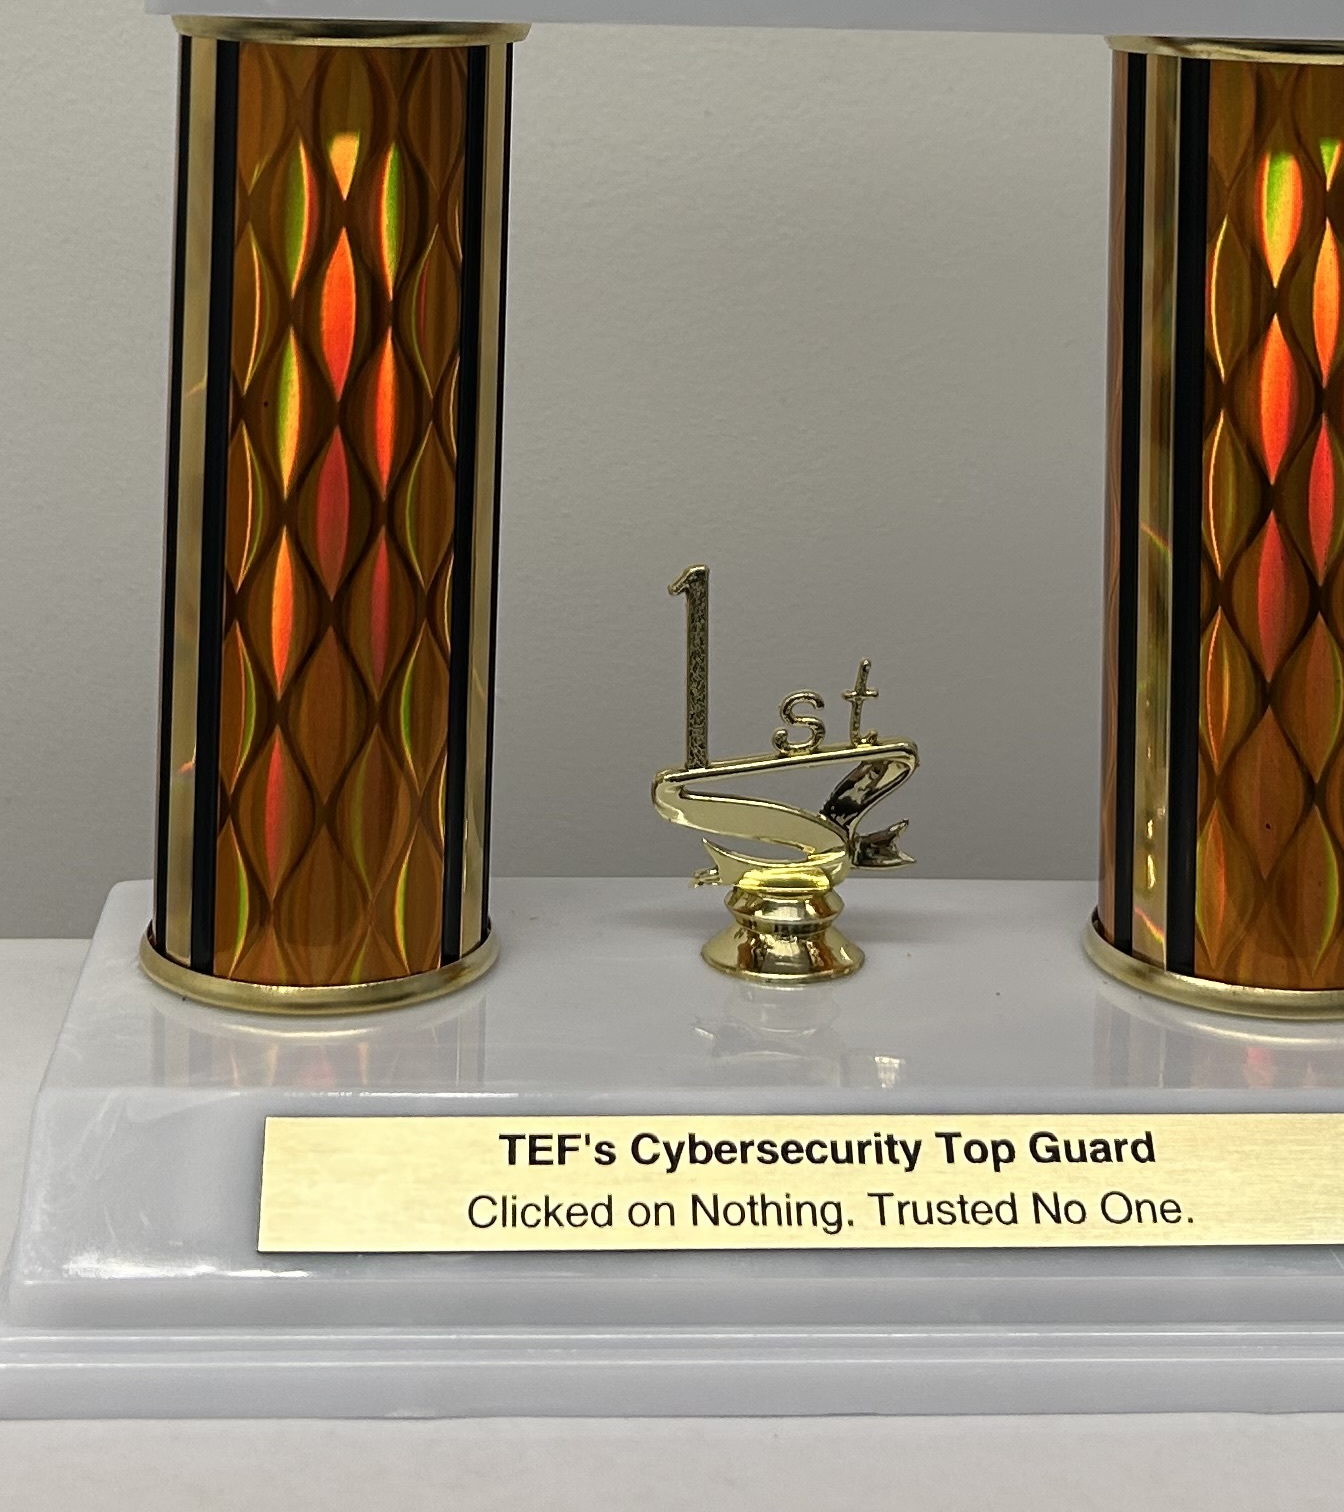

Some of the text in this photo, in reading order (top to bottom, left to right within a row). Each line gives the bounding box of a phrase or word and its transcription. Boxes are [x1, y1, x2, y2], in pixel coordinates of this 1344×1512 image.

[497, 1129, 1157, 1175] TEF's Cybersecurity Top Guard
[467, 1190, 1195, 1236] Clicked on Nothing. Trusted No One.
